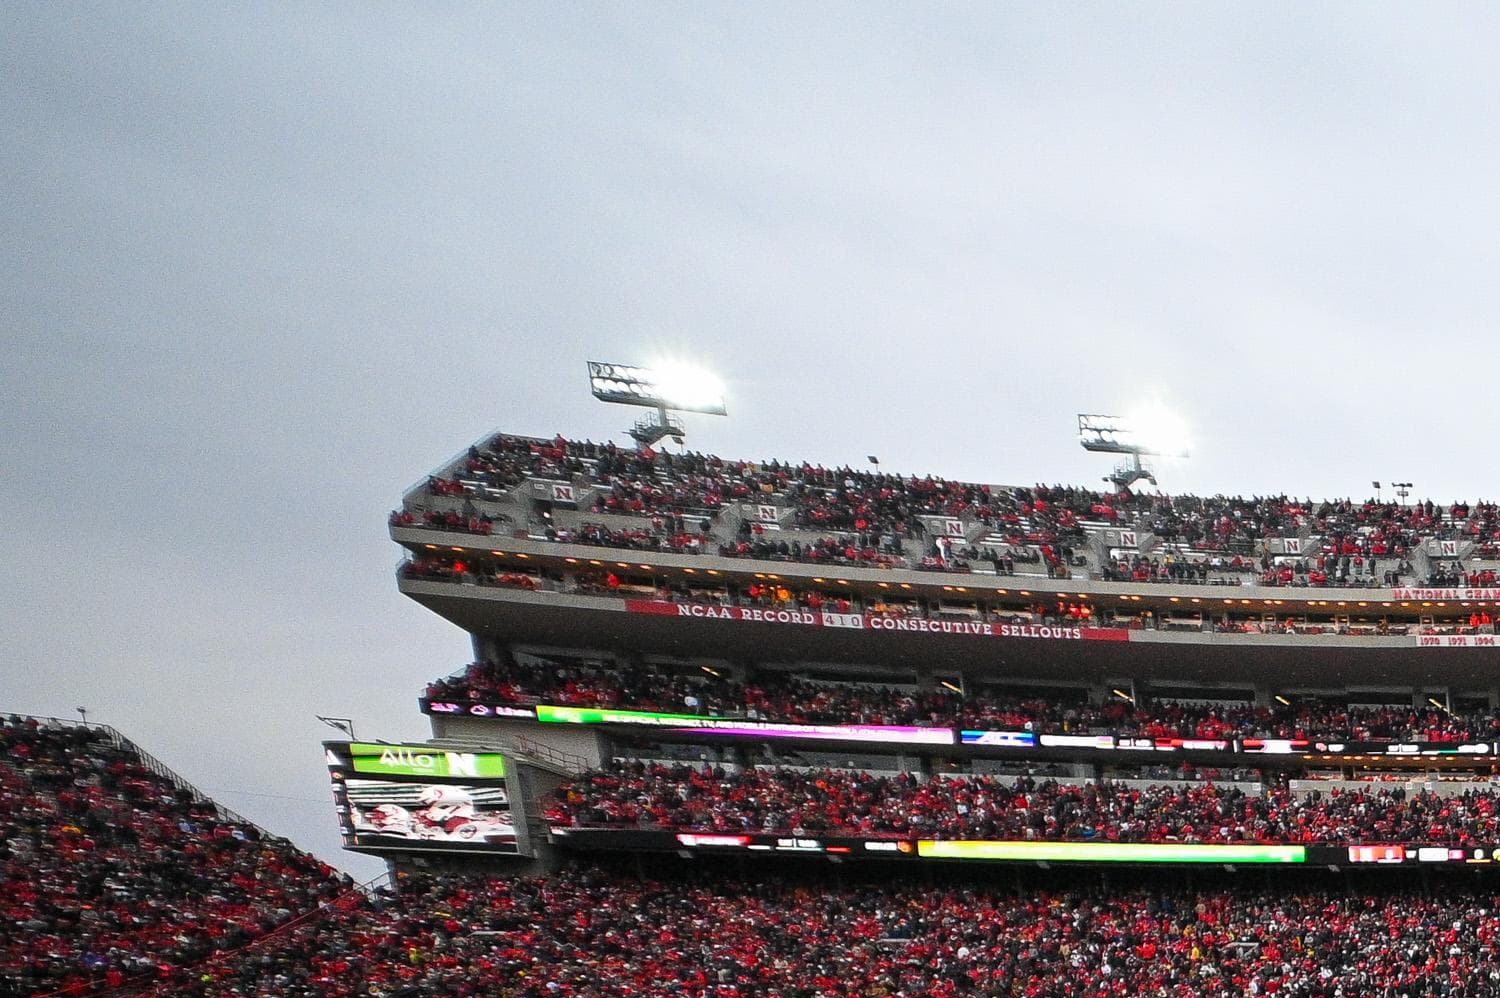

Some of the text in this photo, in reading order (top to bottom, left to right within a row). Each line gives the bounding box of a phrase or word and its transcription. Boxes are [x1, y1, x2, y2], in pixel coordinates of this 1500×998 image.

[556, 487, 571, 499] N
[760, 507, 775, 519] N
[948, 523, 962, 535] N
[1122, 534, 1136, 545] N
[1286, 540, 1298, 551] N
[1443, 542, 1455, 554] N
[677, 604, 1081, 639] NCAA RECORD 410 CONSECUTIVE SELLOUTS
